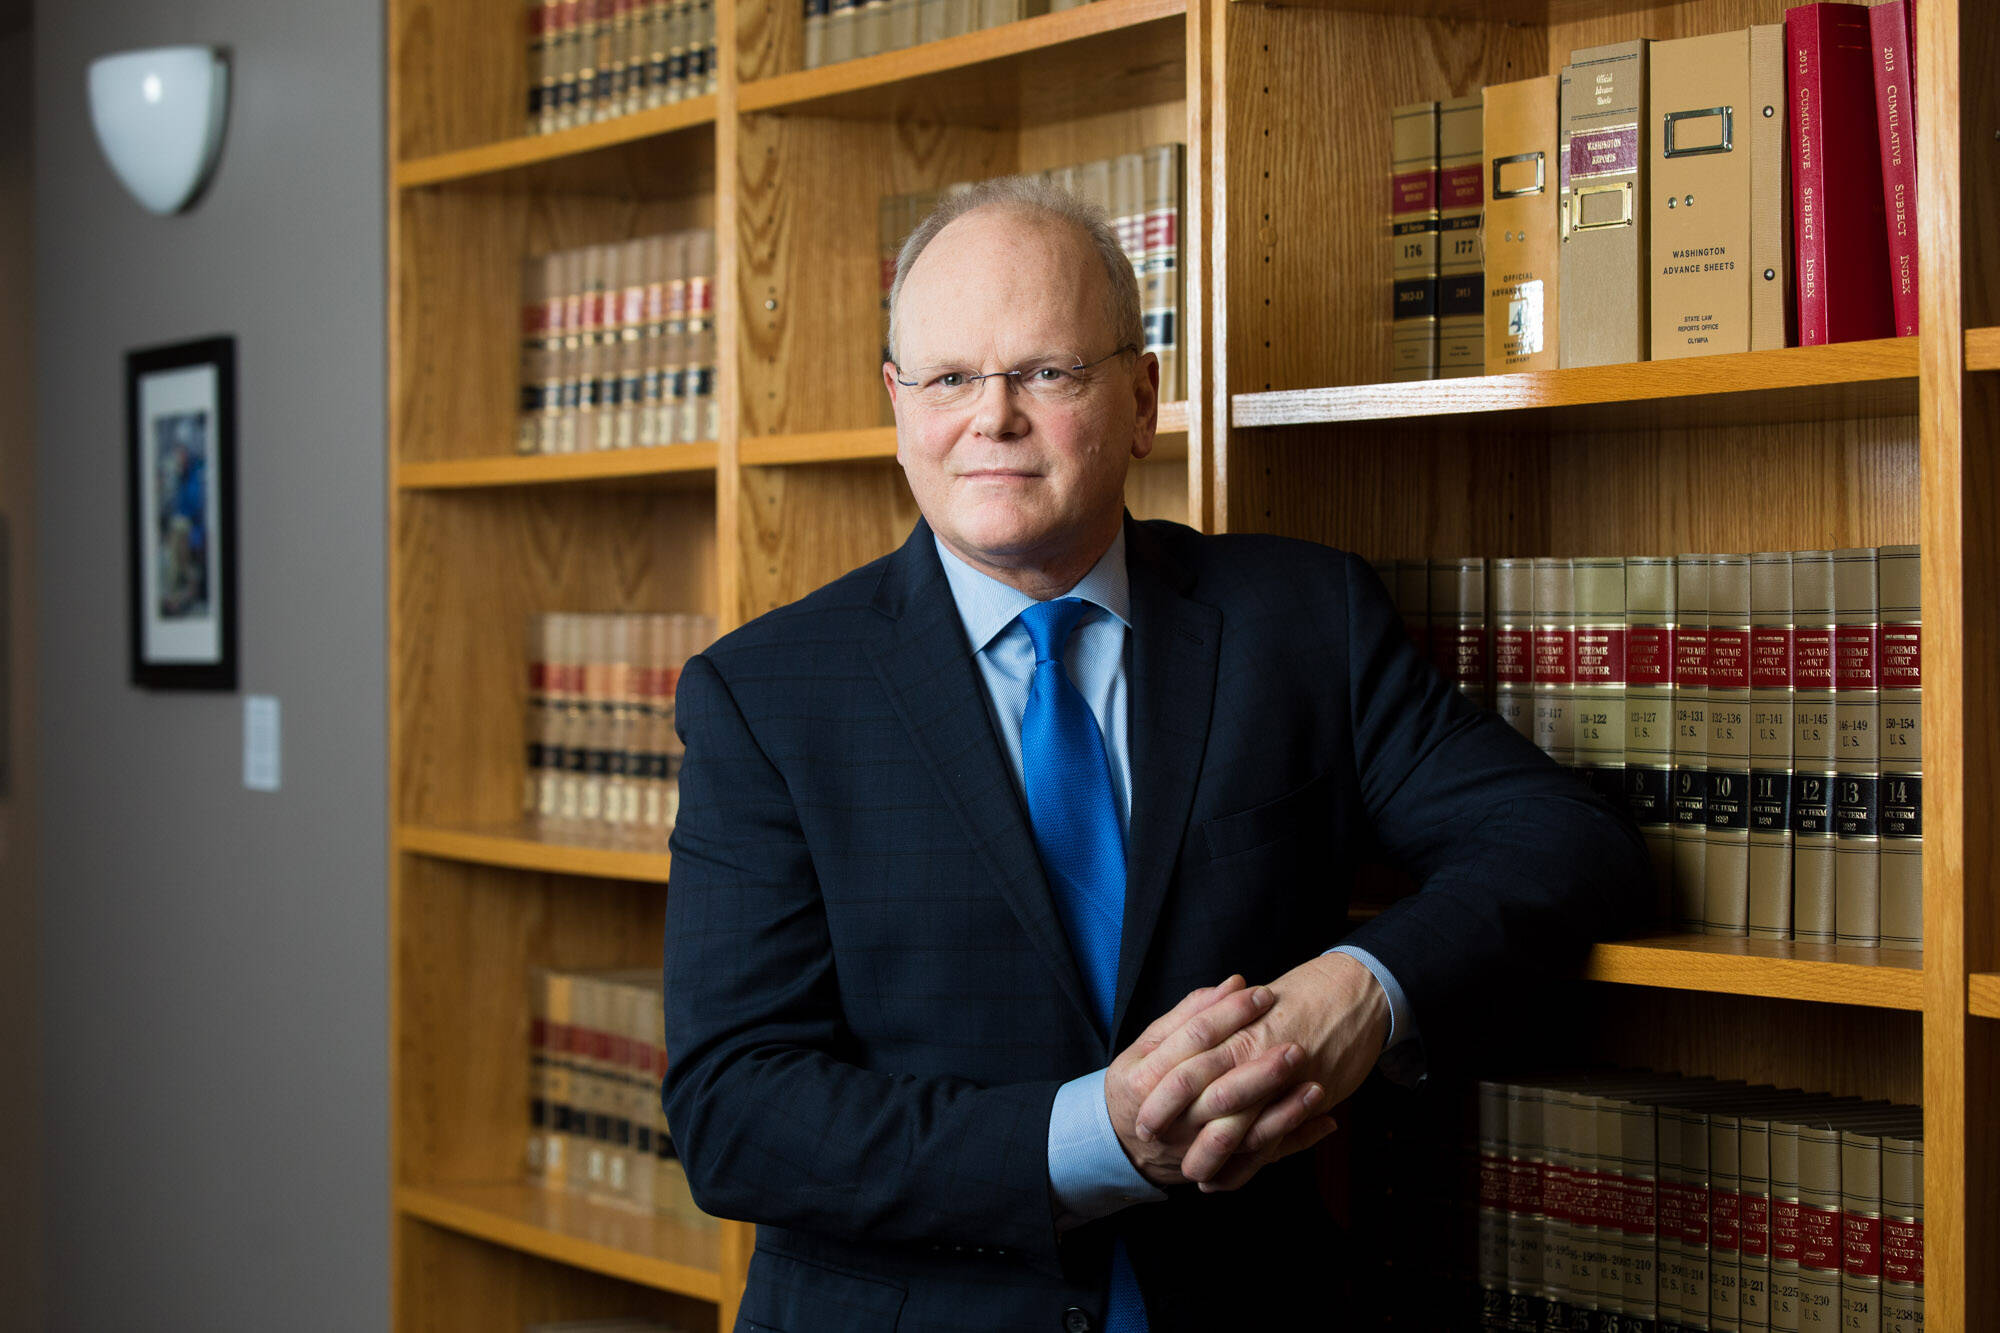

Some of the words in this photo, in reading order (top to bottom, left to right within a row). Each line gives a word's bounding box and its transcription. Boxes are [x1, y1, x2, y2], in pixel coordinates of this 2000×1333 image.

[1799, 49, 1808, 75] 2013
[1884, 47, 1895, 72] 2013
[1800, 87, 1811, 170] CUMULATIVE
[1887, 85, 1902, 167] CUMULATIVE
[1587, 138, 1622, 151] WASHINGTON
[1592, 153, 1616, 165] REPORTS
[1804, 187, 1813, 240] SUBJECT
[1895, 184, 1907, 237] SUBJECT
[1404, 245, 1422, 258] 176
[1456, 240, 1473, 254] 177
[1672, 247, 1726, 258] WASHINGTON
[1503, 272, 1533, 283] OFFICIAL
[1663, 264, 1701, 275] ADVANCE
[1704, 261, 1735, 272] SHEETS
[1806, 258, 1815, 298] INDEX
[1900, 254, 1911, 295] INDEX
[1702, 323, 1719, 331] OFFICE
[1809, 329, 1815, 339] 3
[1886, 718, 1914, 728] 150-154
[1635, 772, 1644, 792] 8
[1682, 773, 1691, 793] 9
[1715, 776, 1732, 797] 10
[1758, 777, 1774, 797] 11
[1802, 780, 1820, 800] 12
[1889, 781, 1907, 803] 14
[1841, 782, 1859, 803] 13
